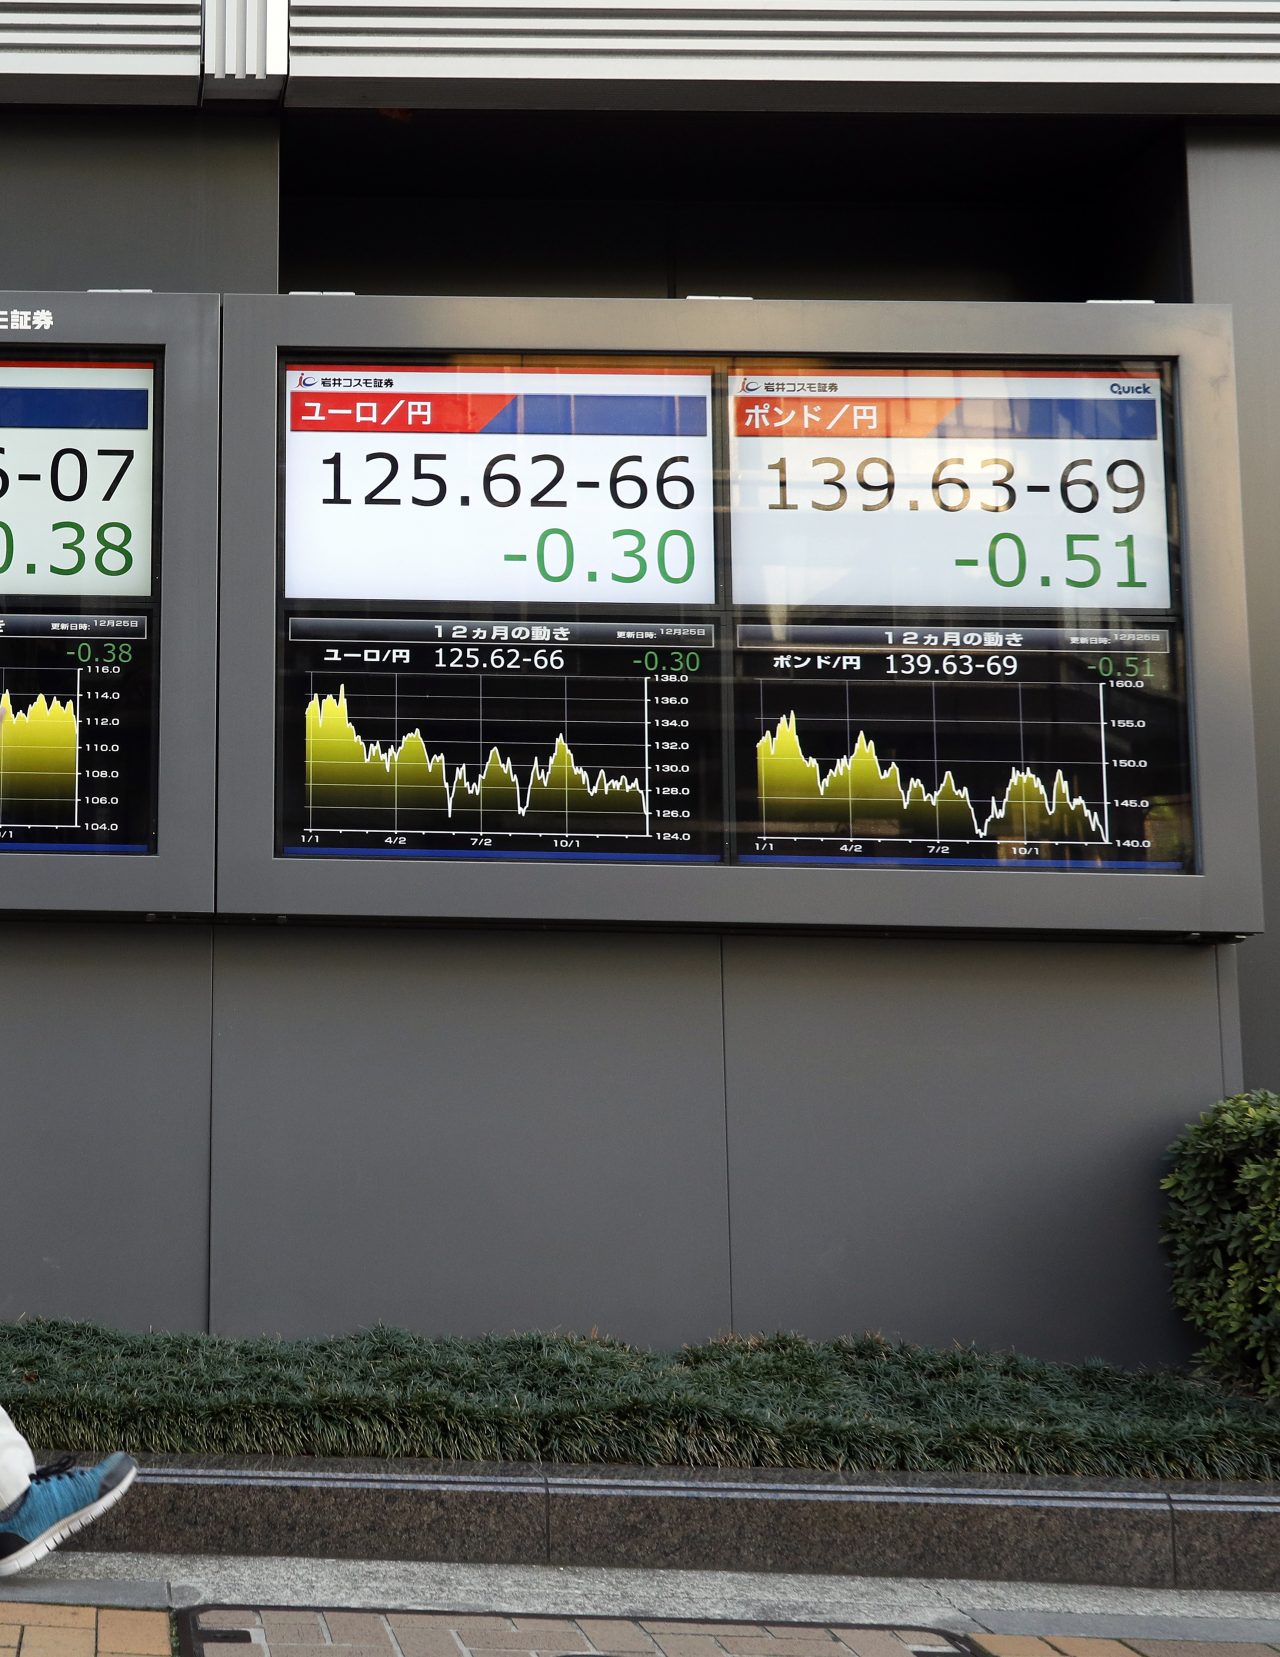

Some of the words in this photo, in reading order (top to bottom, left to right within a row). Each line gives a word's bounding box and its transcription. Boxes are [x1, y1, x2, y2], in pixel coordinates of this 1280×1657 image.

[321, 377, 394, 388] 岩井コスモ証券
[764, 382, 838, 393] 岩井コスモ証券
[322, 452, 694, 509] 125.62-66
[768, 457, 1146, 513] 139.63-69
[504, 528, 695, 583] -0.30
[955, 533, 1147, 588] -0.51
[67, 643, 132, 663] -0.38
[324, 649, 410, 664] ユーロ/円
[435, 648, 564, 669] 125.62-66
[633, 651, 699, 672] -0.30
[87, 665, 120, 674] 116.0
[774, 655, 860, 670] ポンド/円
[886, 654, 1018, 675] 139.63-69
[1087, 657, 1154, 677] -0.51
[654, 674, 688, 682] 138.0
[1109, 679, 1144, 688] 160.0
[87, 691, 120, 699] 114.0
[654, 696, 688, 705] 136.0
[86, 717, 119, 726] 112.0
[654, 719, 689, 727] 134.0
[1110, 719, 1146, 728] 155.0
[86, 743, 119, 752] 110.0
[654, 742, 689, 750] 132.0
[1112, 759, 1147, 768] 150.0
[655, 764, 690, 773] 130.0
[85, 770, 118, 778] 108.0
[655, 787, 690, 795] 128.0
[85, 796, 118, 805] 106.0
[1113, 799, 1149, 807] 145.0
[655, 809, 690, 817] 126.0
[84, 822, 118, 831] 104.0
[301, 835, 319, 843] 1/1
[385, 836, 406, 844] 4/2
[471, 838, 492, 846] 7/2
[554, 839, 580, 847] 10/1
[655, 832, 691, 841] 124.0
[1115, 839, 1151, 848] 140.0
[755, 843, 774, 851] 1/1
[840, 844, 862, 852] 4/2
[927, 846, 950, 854] 7/2
[1012, 847, 1039, 855] 10/1
